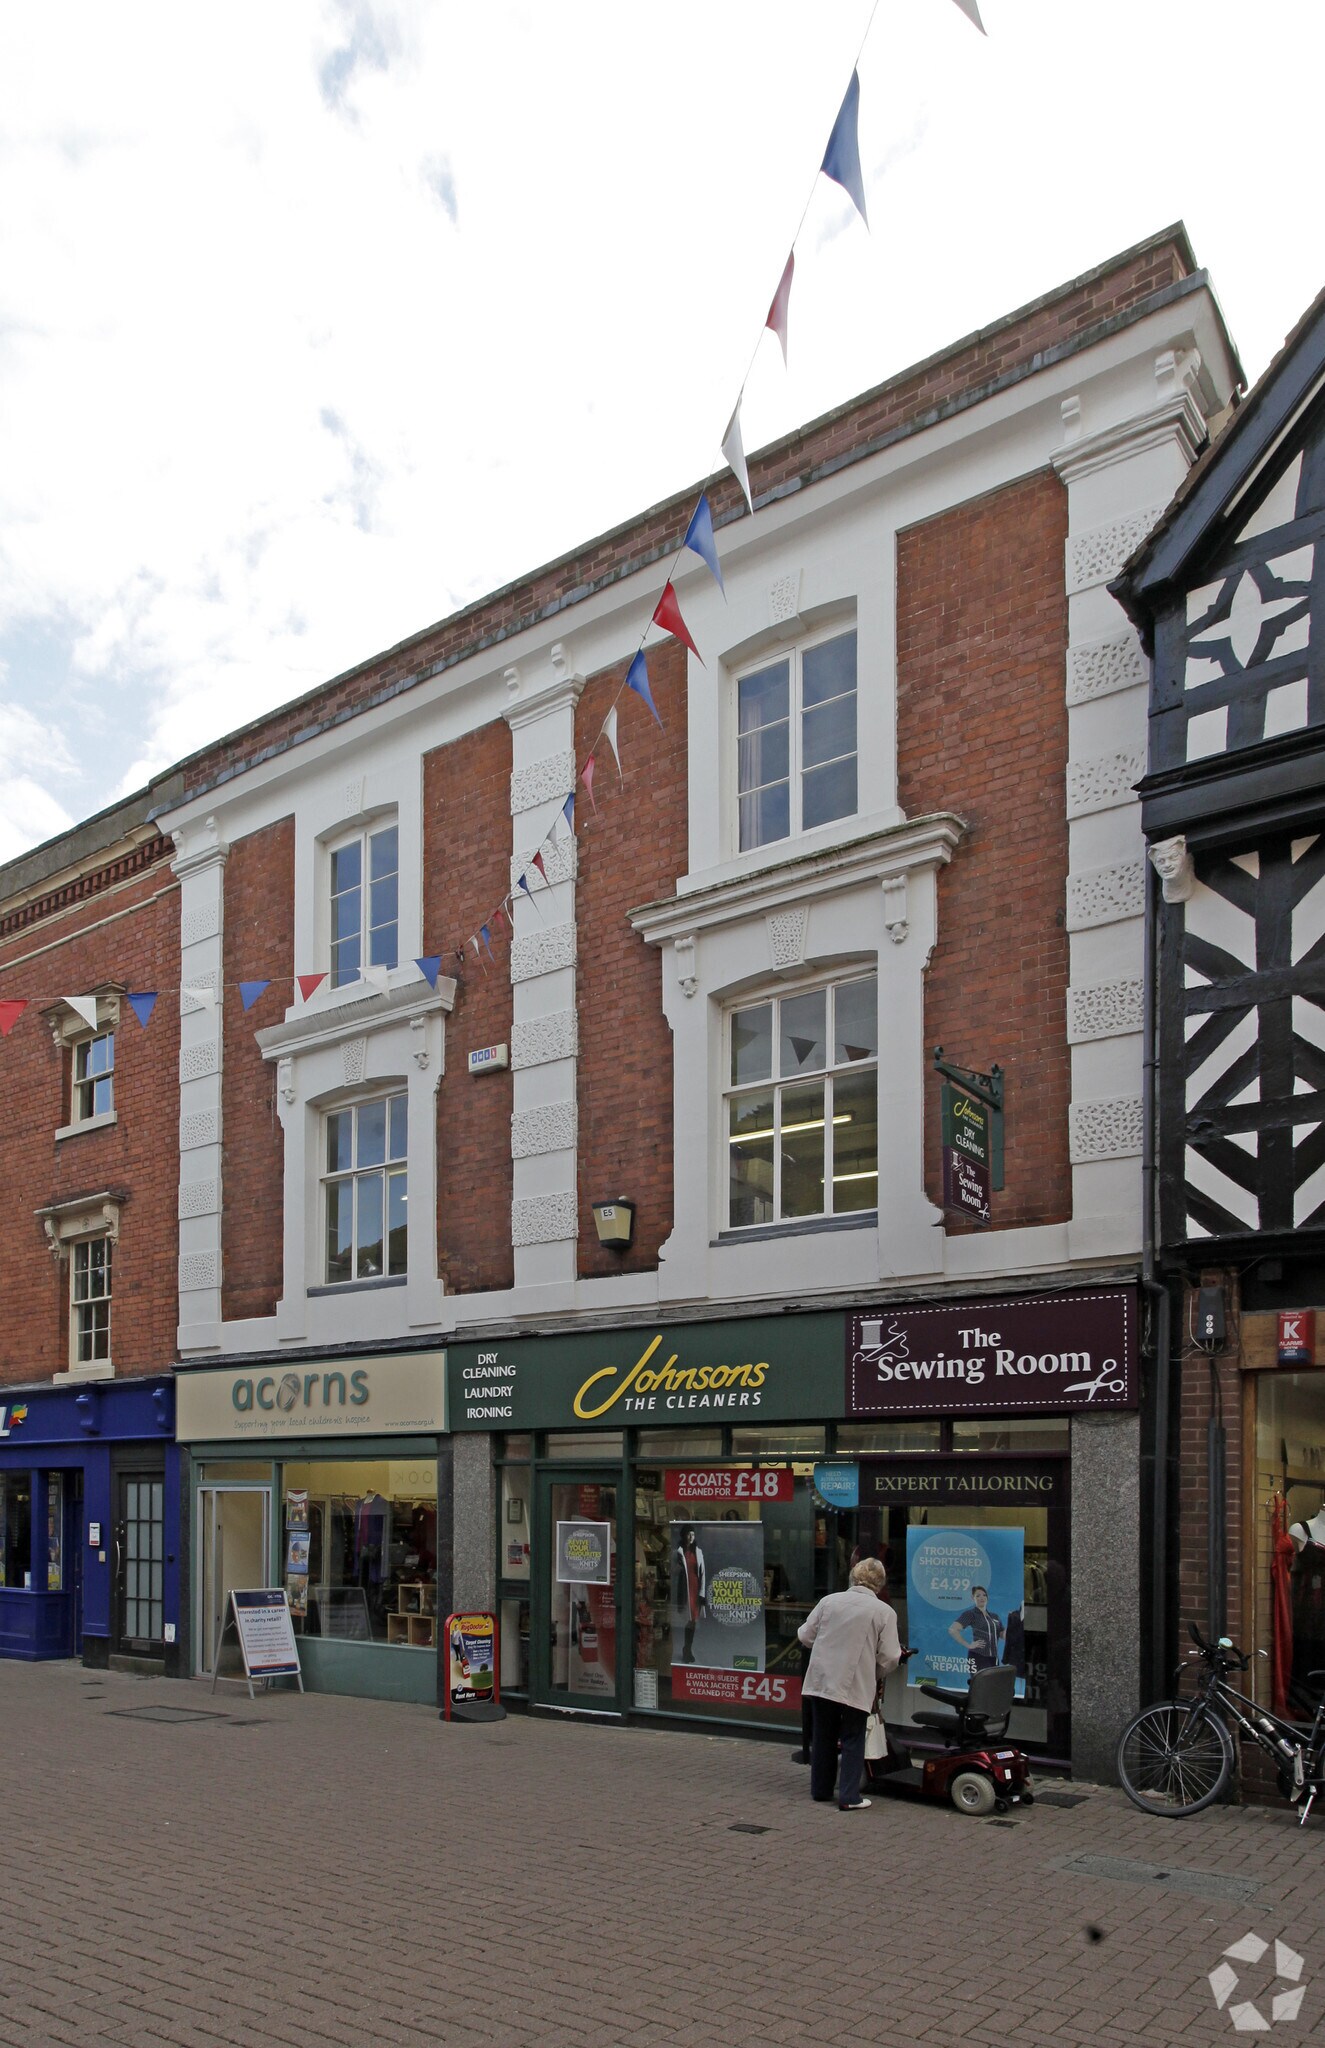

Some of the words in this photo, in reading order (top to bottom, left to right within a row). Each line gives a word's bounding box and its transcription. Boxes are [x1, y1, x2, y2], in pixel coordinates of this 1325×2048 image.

[954, 1099, 984, 1125] Johnsons
[964, 1126, 975, 1140] DRY
[956, 1134, 985, 1158] CLEANING
[966, 1164, 976, 1177] The
[959, 1173, 983, 1198] Sewing
[962, 1188, 981, 1208] Room
[1283, 1321, 1300, 1339] K
[958, 1328, 1001, 1349] The
[478, 1353, 498, 1365] DRY
[463, 1365, 516, 1379] CLEANING
[877, 1352, 986, 1384] Sewing
[995, 1349, 1091, 1376] Room
[573, 1334, 769, 1419] Johnsons
[232, 1370, 370, 1411] acorns
[465, 1385, 514, 1399] LAUNDRY
[625, 1397, 657, 1411] THE
[666, 1392, 762, 1409] CLEANERS
[467, 1406, 512, 1419] IRONING
[270, 1420, 286, 1433] your
[289, 1416, 307, 1426] local
[345, 1415, 370, 1427] hospice
[679, 1473, 686, 1487] 2
[688, 1473, 732, 1486] COATS
[735, 1472, 779, 1497] £18
[820, 1482, 856, 1490] REPAIR?
[875, 1476, 942, 1491] EXPERT
[945, 1476, 1053, 1491] TAILORING
[678, 1488, 714, 1496] CLEANED
[714, 1488, 731, 1496] FOR
[924, 1547, 978, 1556] TROUSERS
[920, 1557, 982, 1567] SHORTENED
[925, 1567, 946, 1576] FOR
[949, 1568, 976, 1577] ONLY
[931, 1577, 971, 1591] £4.99
[714, 1589, 743, 1597] YOUR
[712, 1597, 762, 1606] FAVOURITES
[729, 1610, 757, 1619] KNITS
[925, 1655, 976, 1665] ALTERATIONS
[932, 1662, 978, 1674] REPAIRS
[717, 1675, 739, 1683] SUEDE
[690, 1688, 720, 1697] CLEANED
[721, 1690, 735, 1698] FOR
[710, 1682, 739, 1691] JACKETS
[741, 1676, 787, 1702] £45
